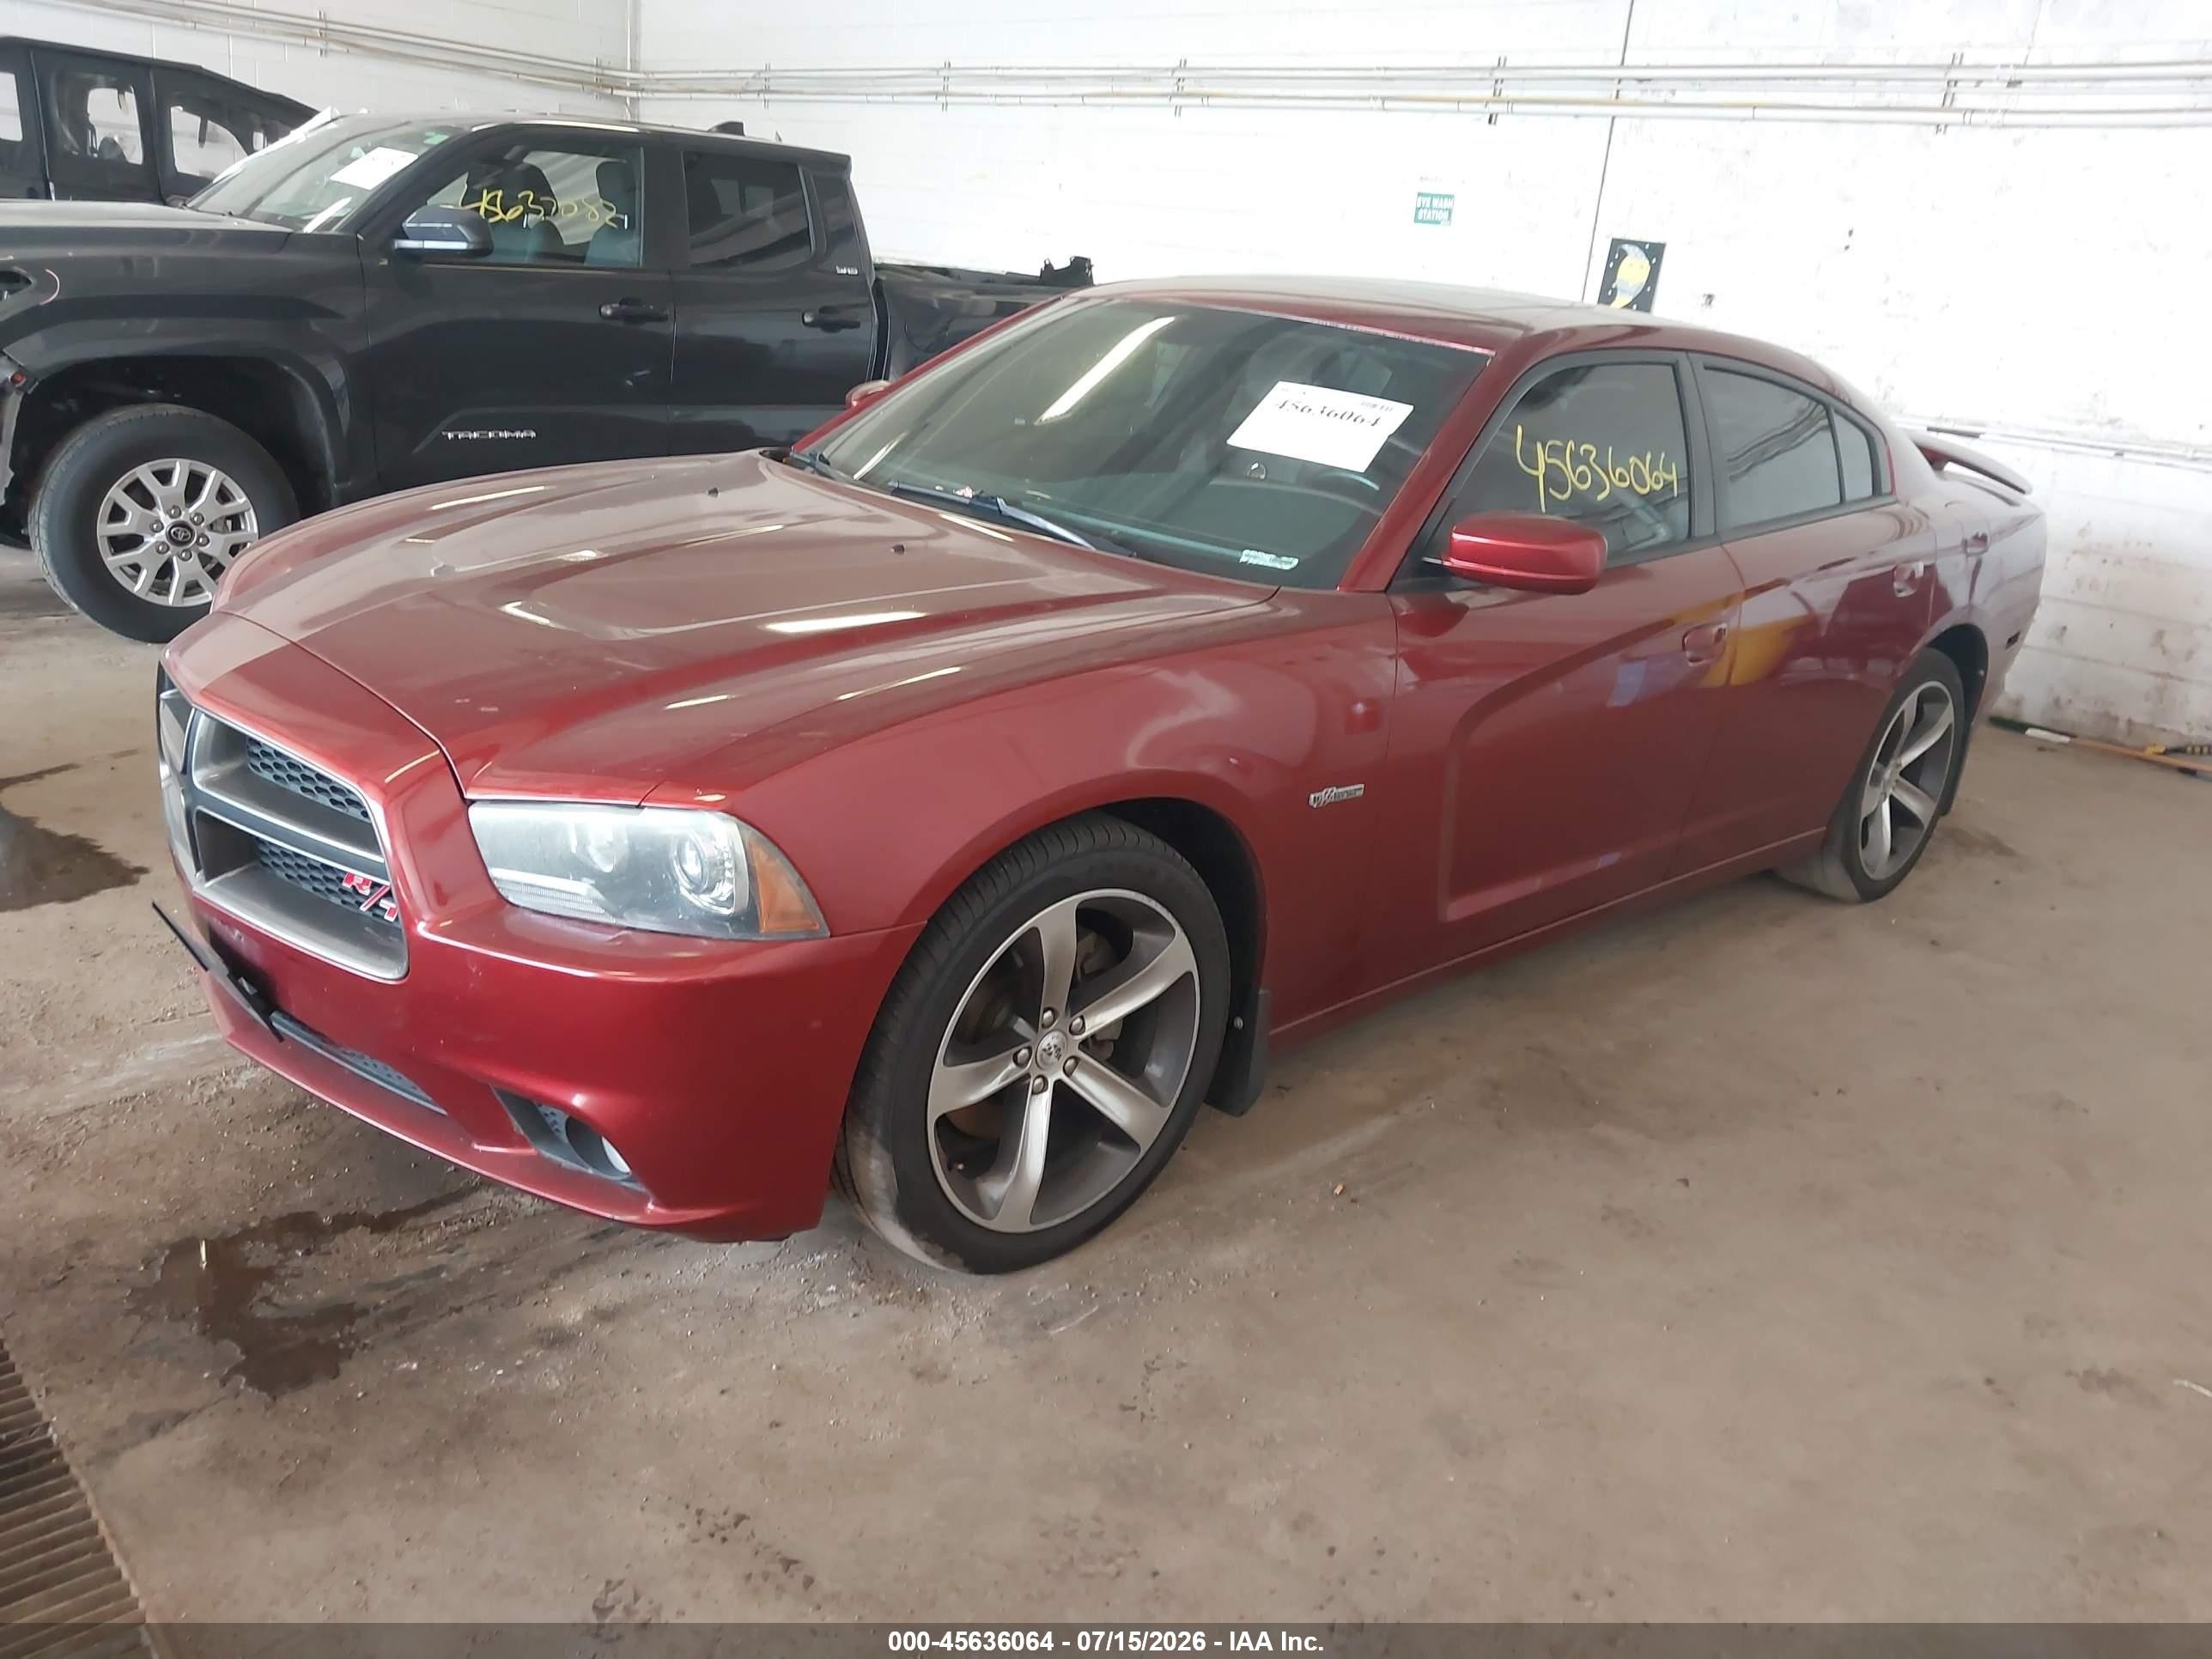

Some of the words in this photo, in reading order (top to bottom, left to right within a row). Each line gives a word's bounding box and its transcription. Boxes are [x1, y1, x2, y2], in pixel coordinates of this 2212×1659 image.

[1275, 398, 1382, 427] 45636064
[441, 429, 537, 441] TACOMA
[1516, 424, 1678, 514] 45636064
[342, 872, 398, 923] R/T
